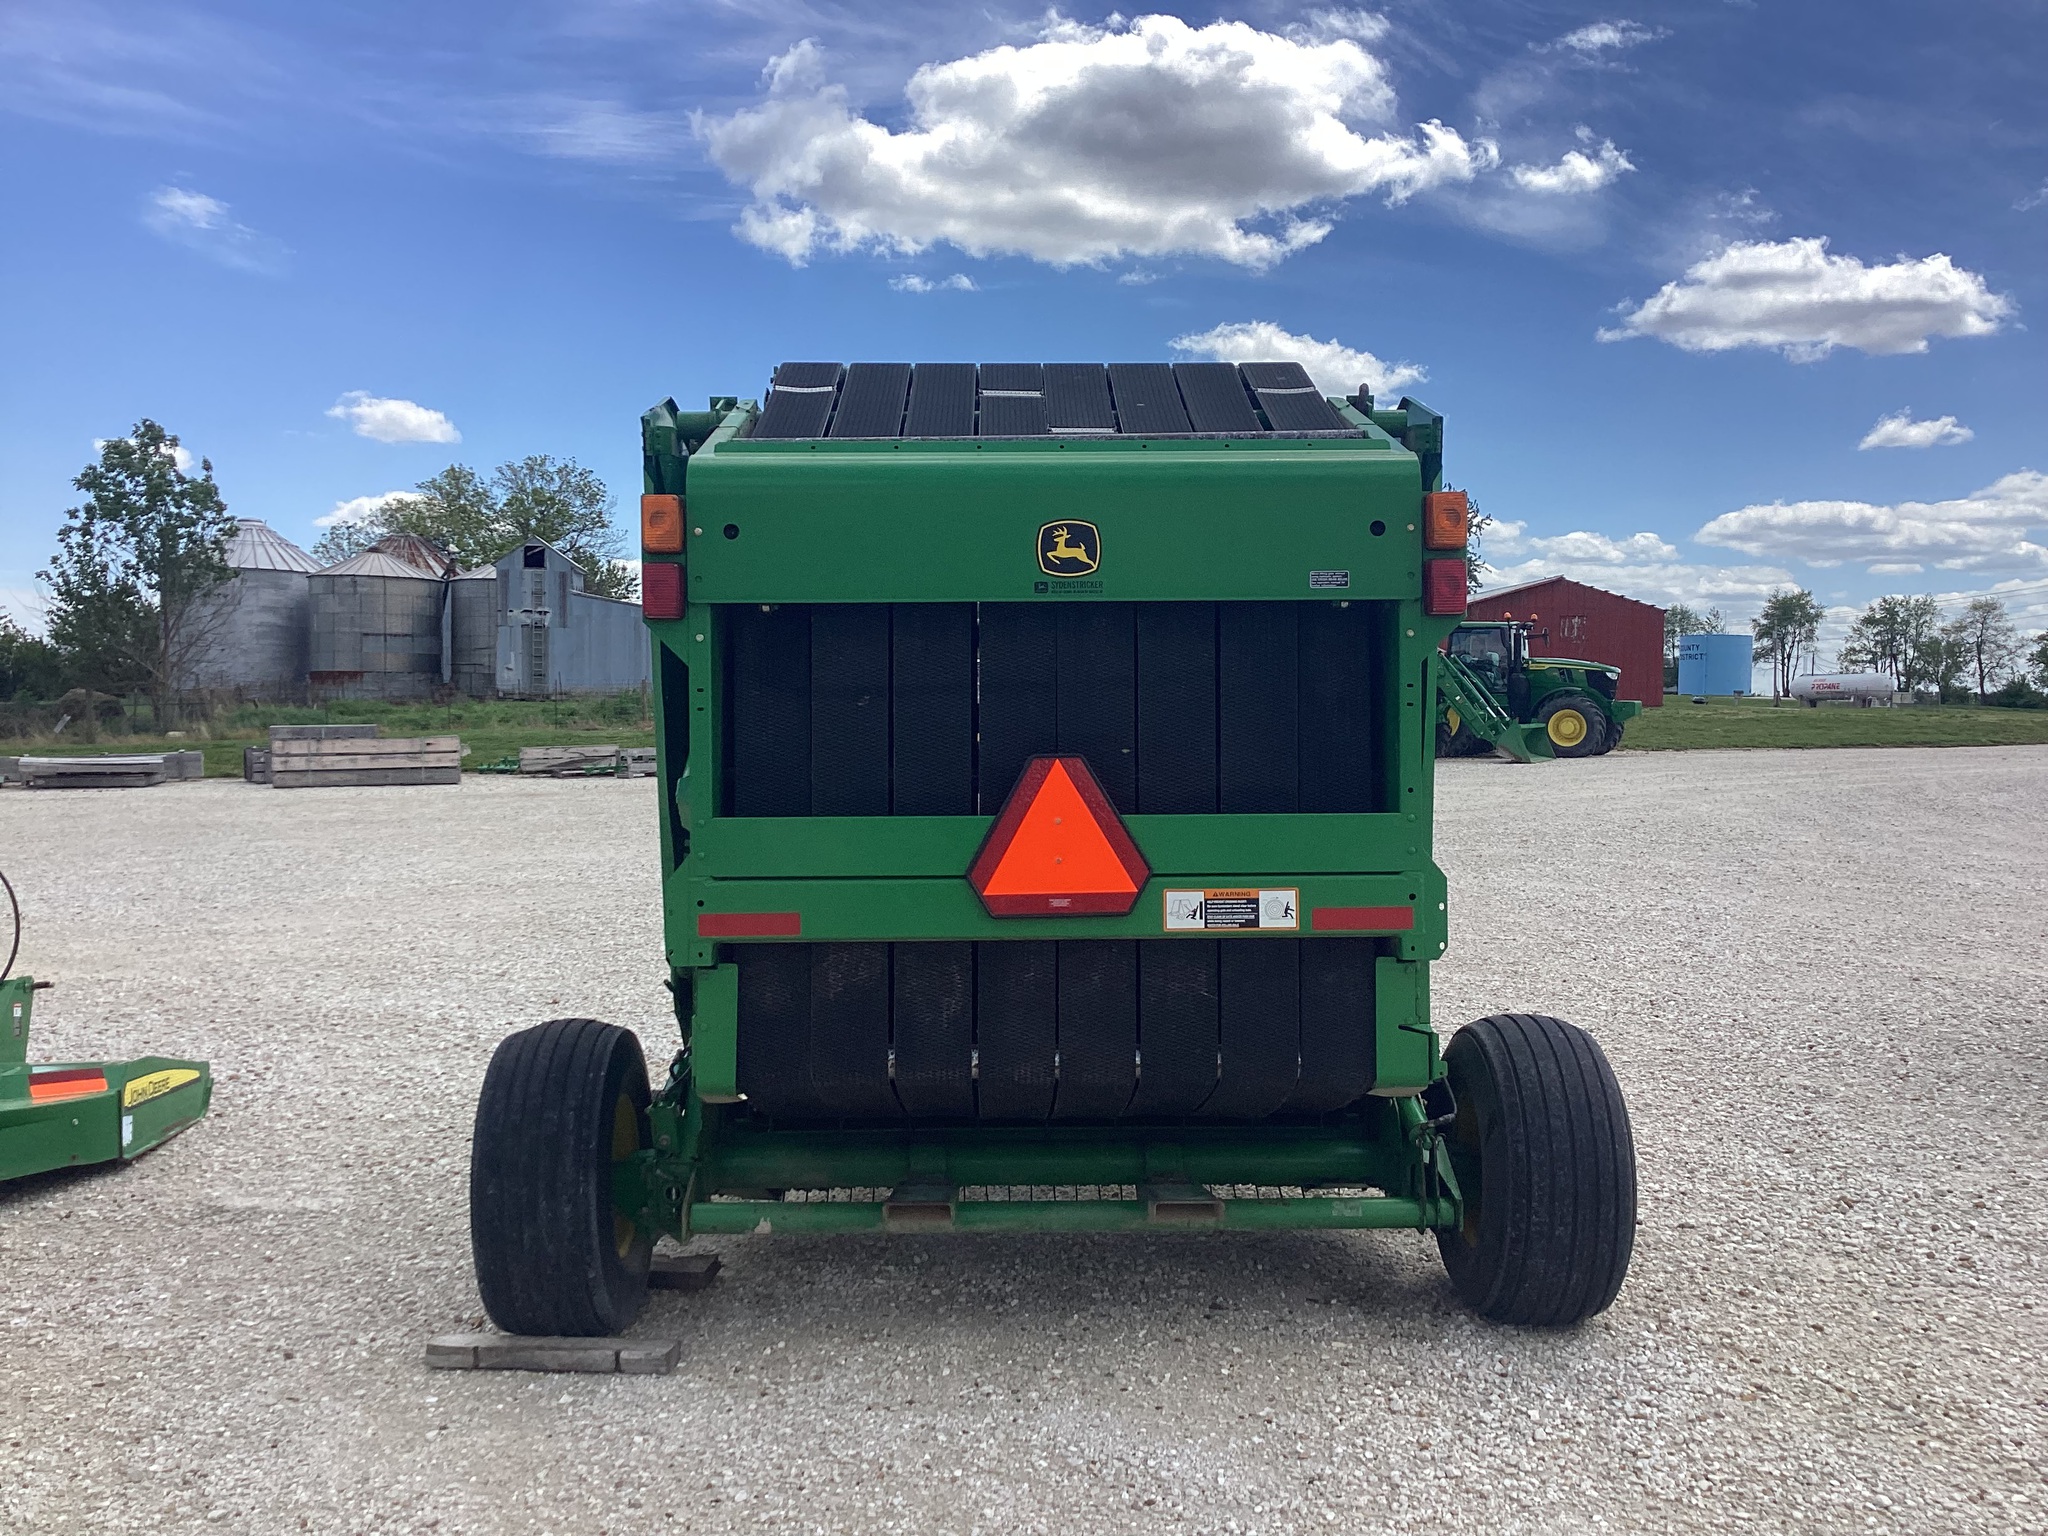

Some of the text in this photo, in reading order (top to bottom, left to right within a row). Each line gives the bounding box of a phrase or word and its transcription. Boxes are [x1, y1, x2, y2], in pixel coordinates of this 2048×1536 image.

[1051, 581, 1104, 589] SYDENSTRICKER
[128, 1077, 170, 1105] JOHN DEERE
